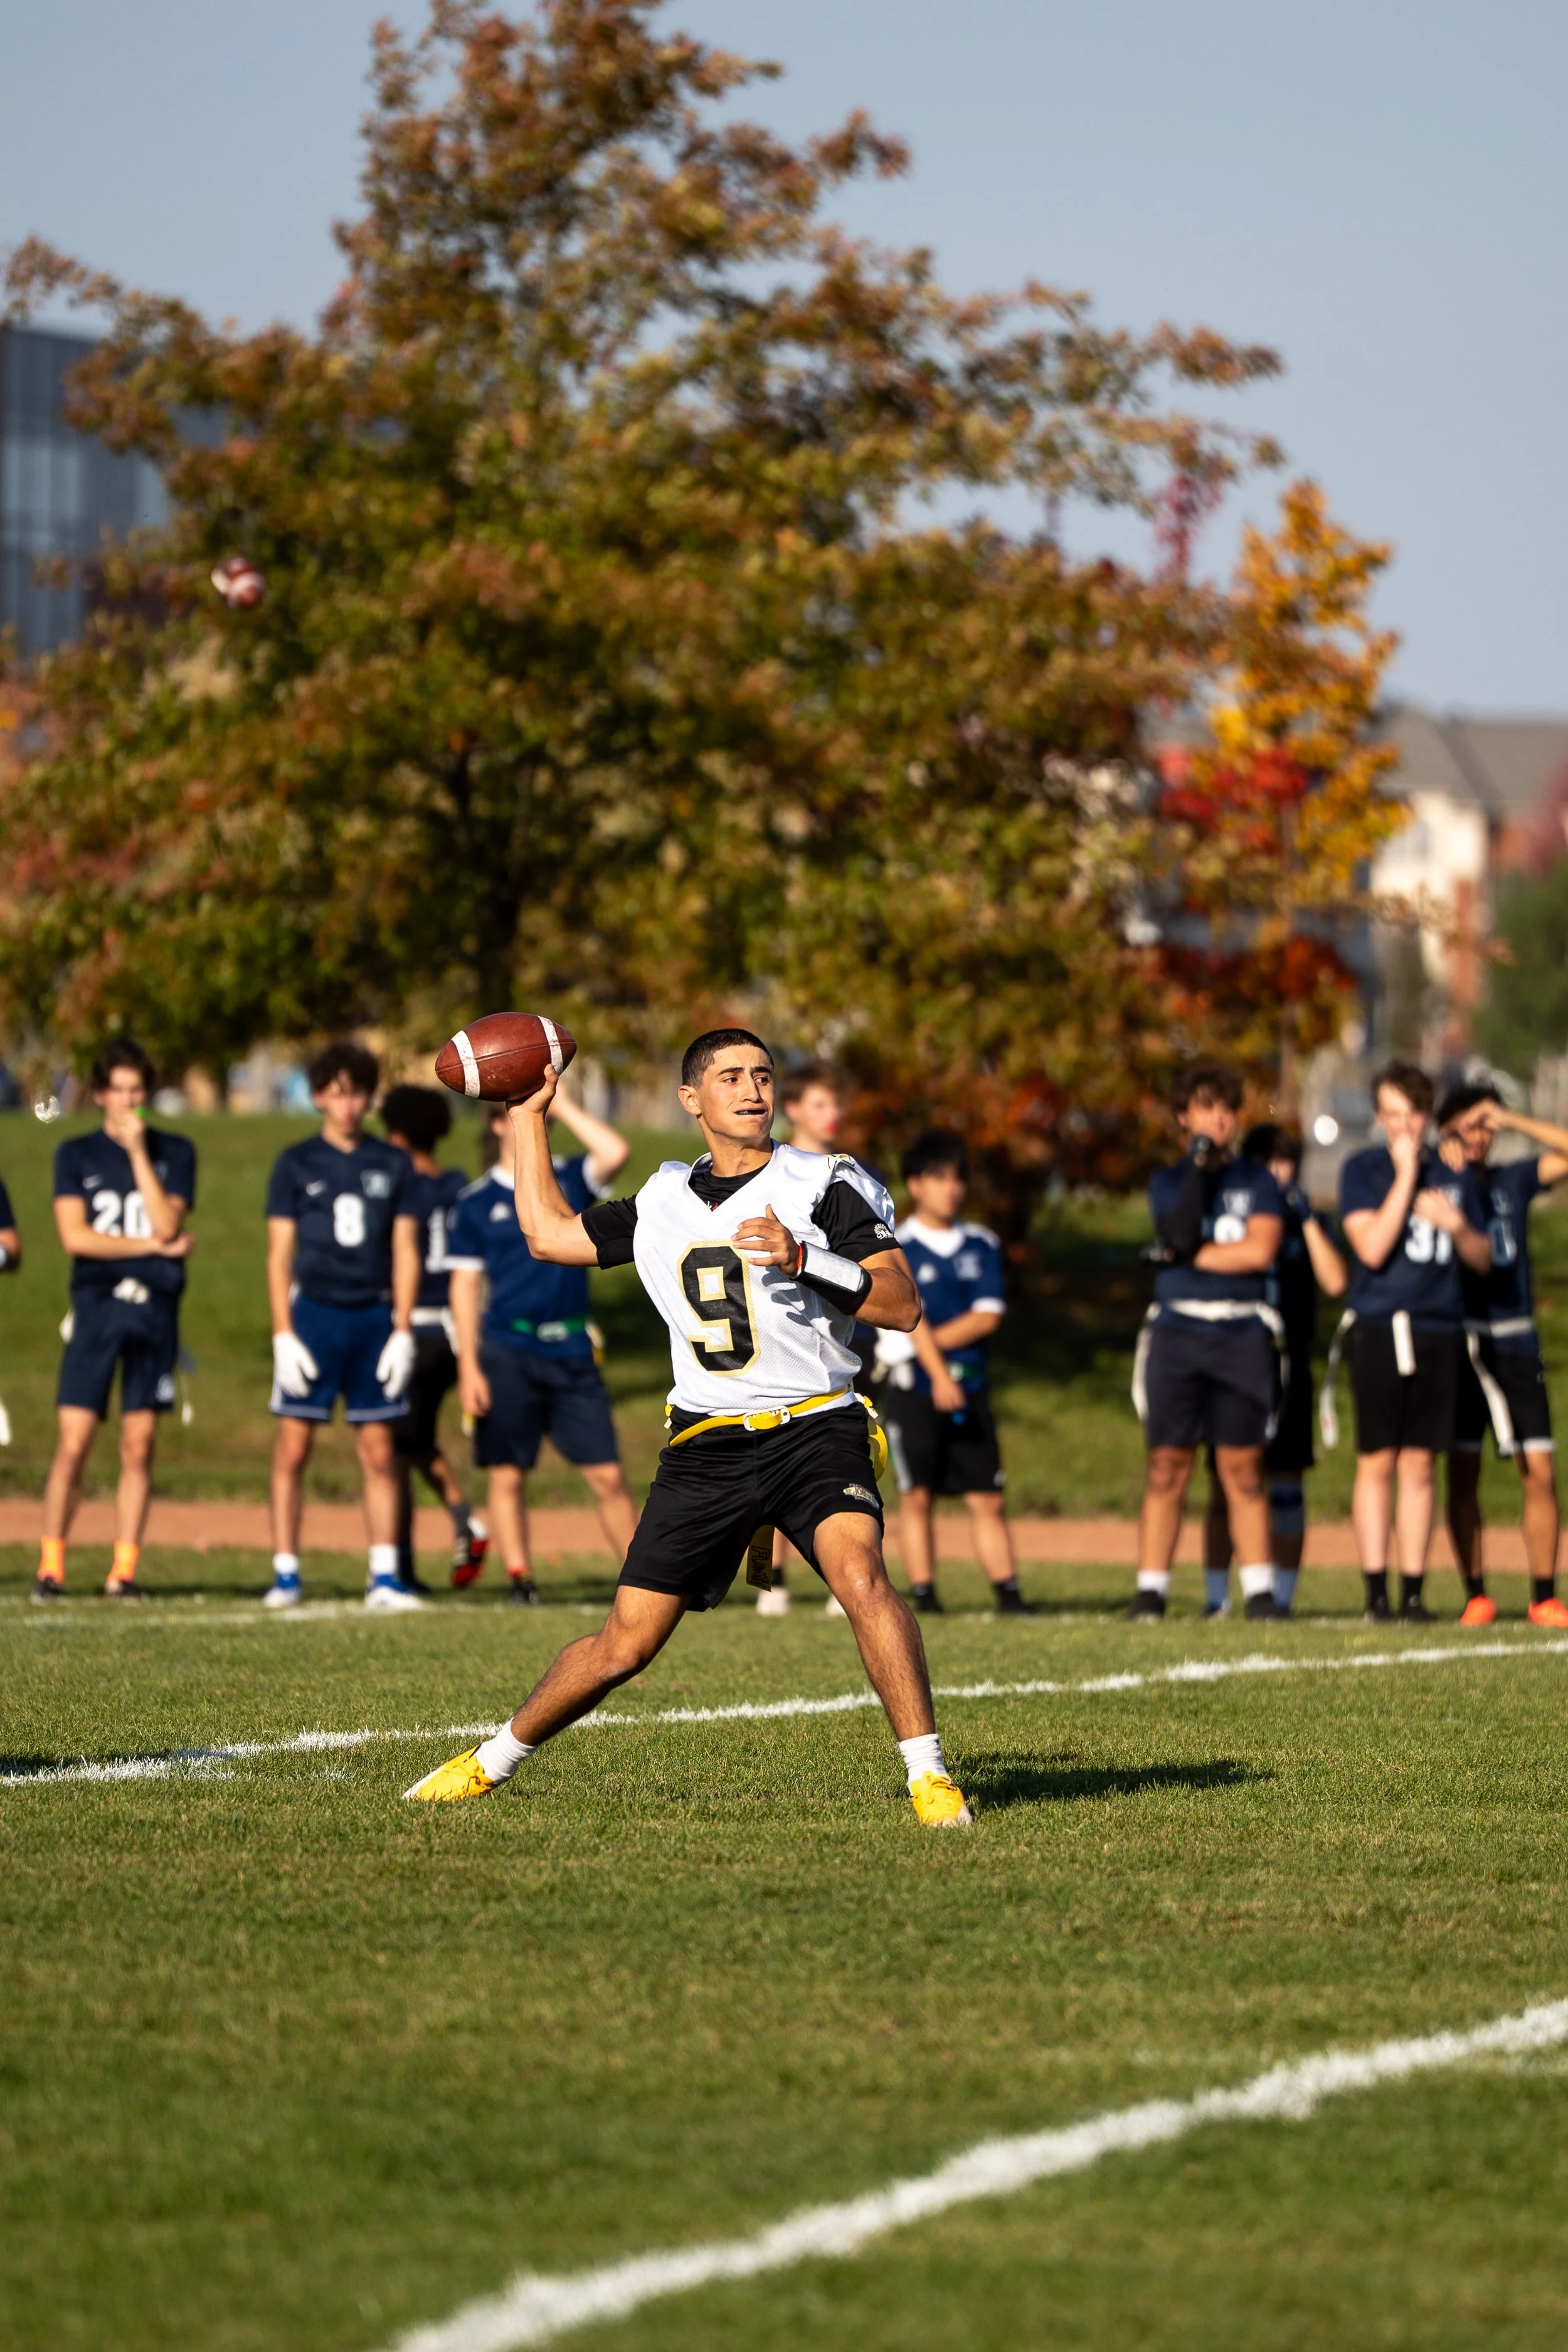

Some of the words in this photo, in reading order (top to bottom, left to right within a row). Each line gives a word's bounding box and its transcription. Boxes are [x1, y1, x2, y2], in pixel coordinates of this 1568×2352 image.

[92, 1190, 152, 1238] 20
[333, 1192, 365, 1248] 8
[677, 1240, 761, 1377] 9
